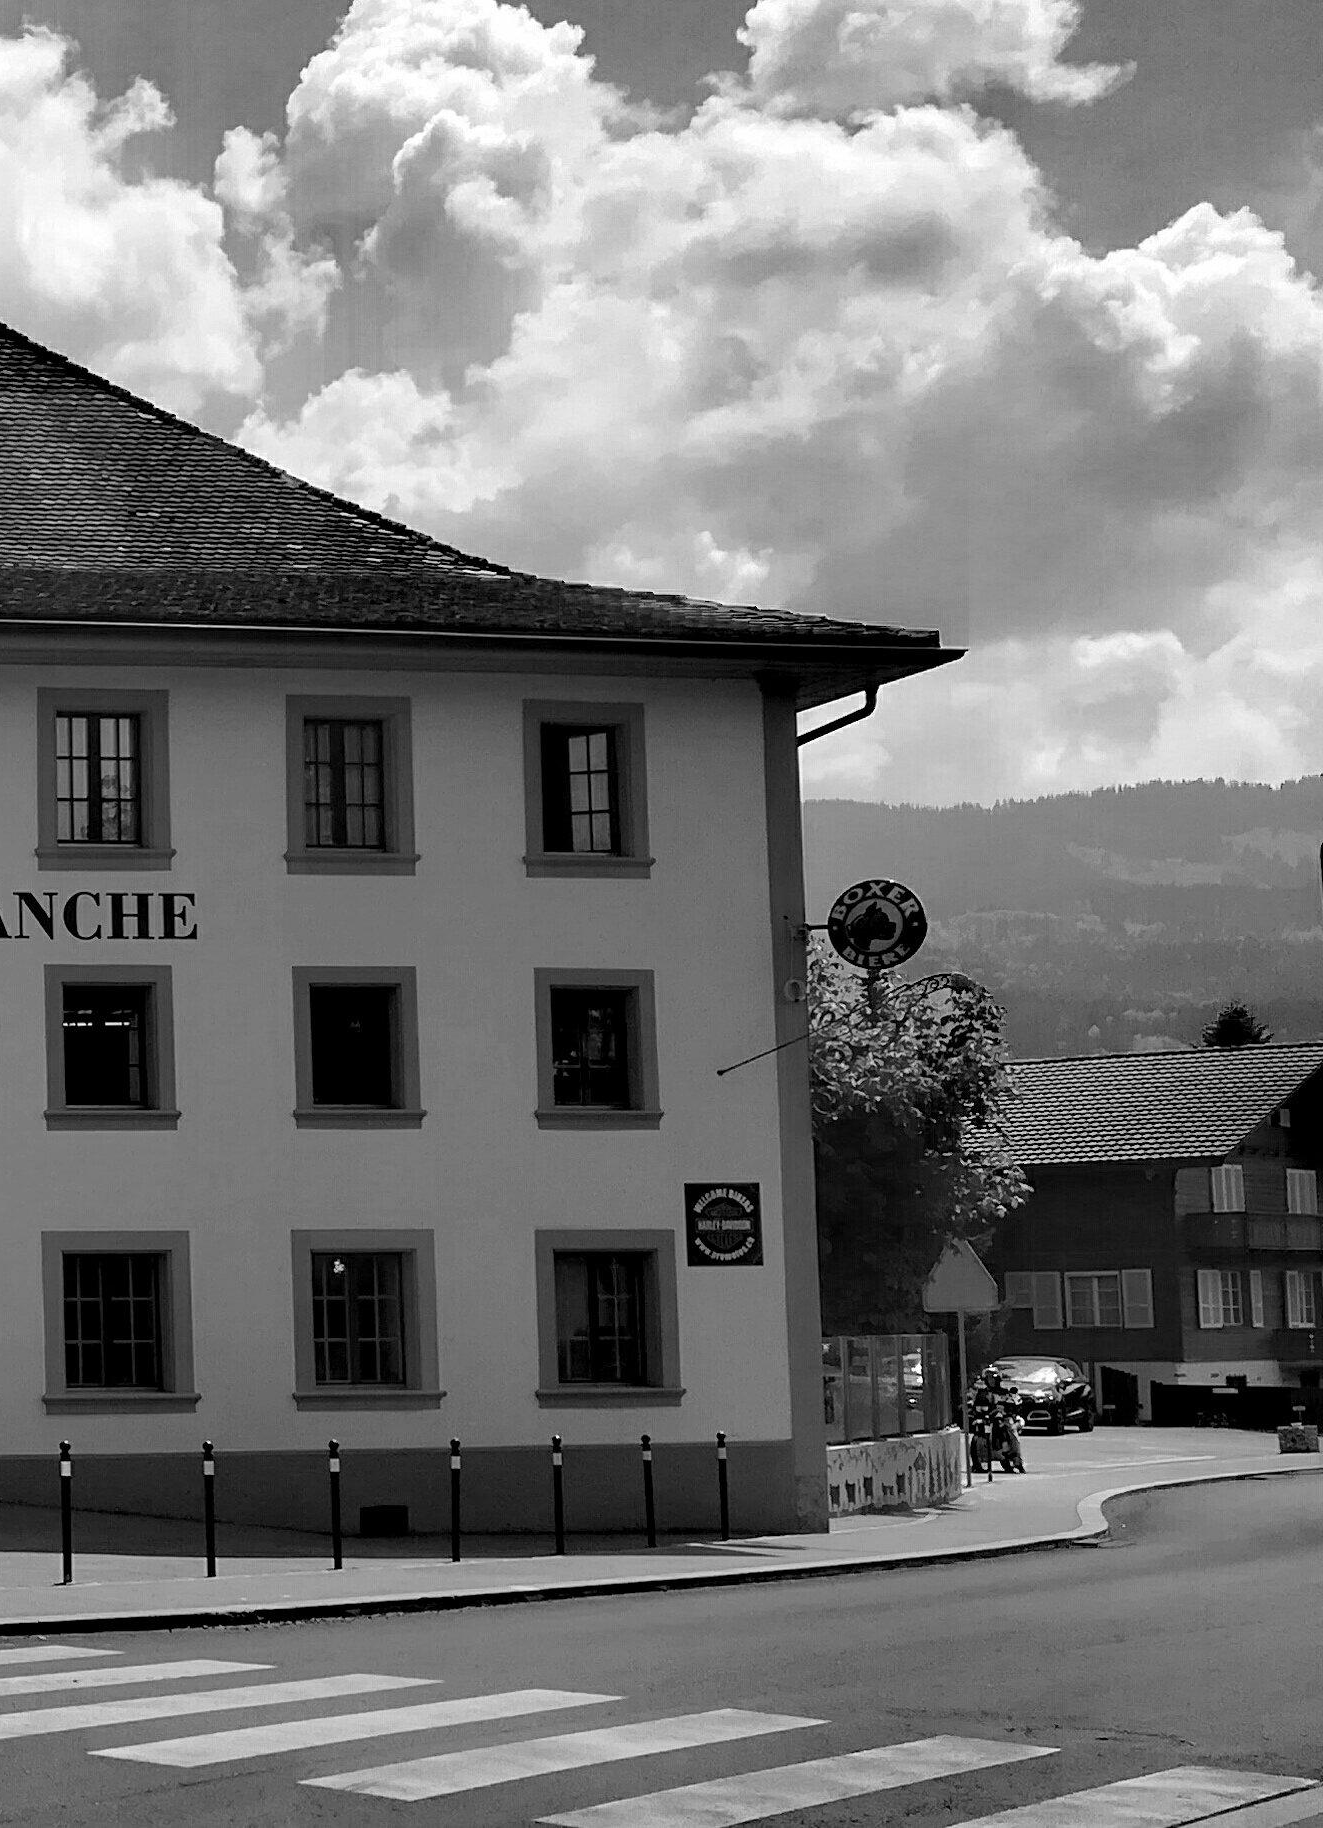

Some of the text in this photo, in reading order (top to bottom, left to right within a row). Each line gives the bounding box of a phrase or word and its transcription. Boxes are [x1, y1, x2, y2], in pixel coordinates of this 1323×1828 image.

[831, 882, 919, 919] BOXER
[693, 1188, 728, 1213] WELCOME
[728, 1189, 754, 1213] BIKERS
